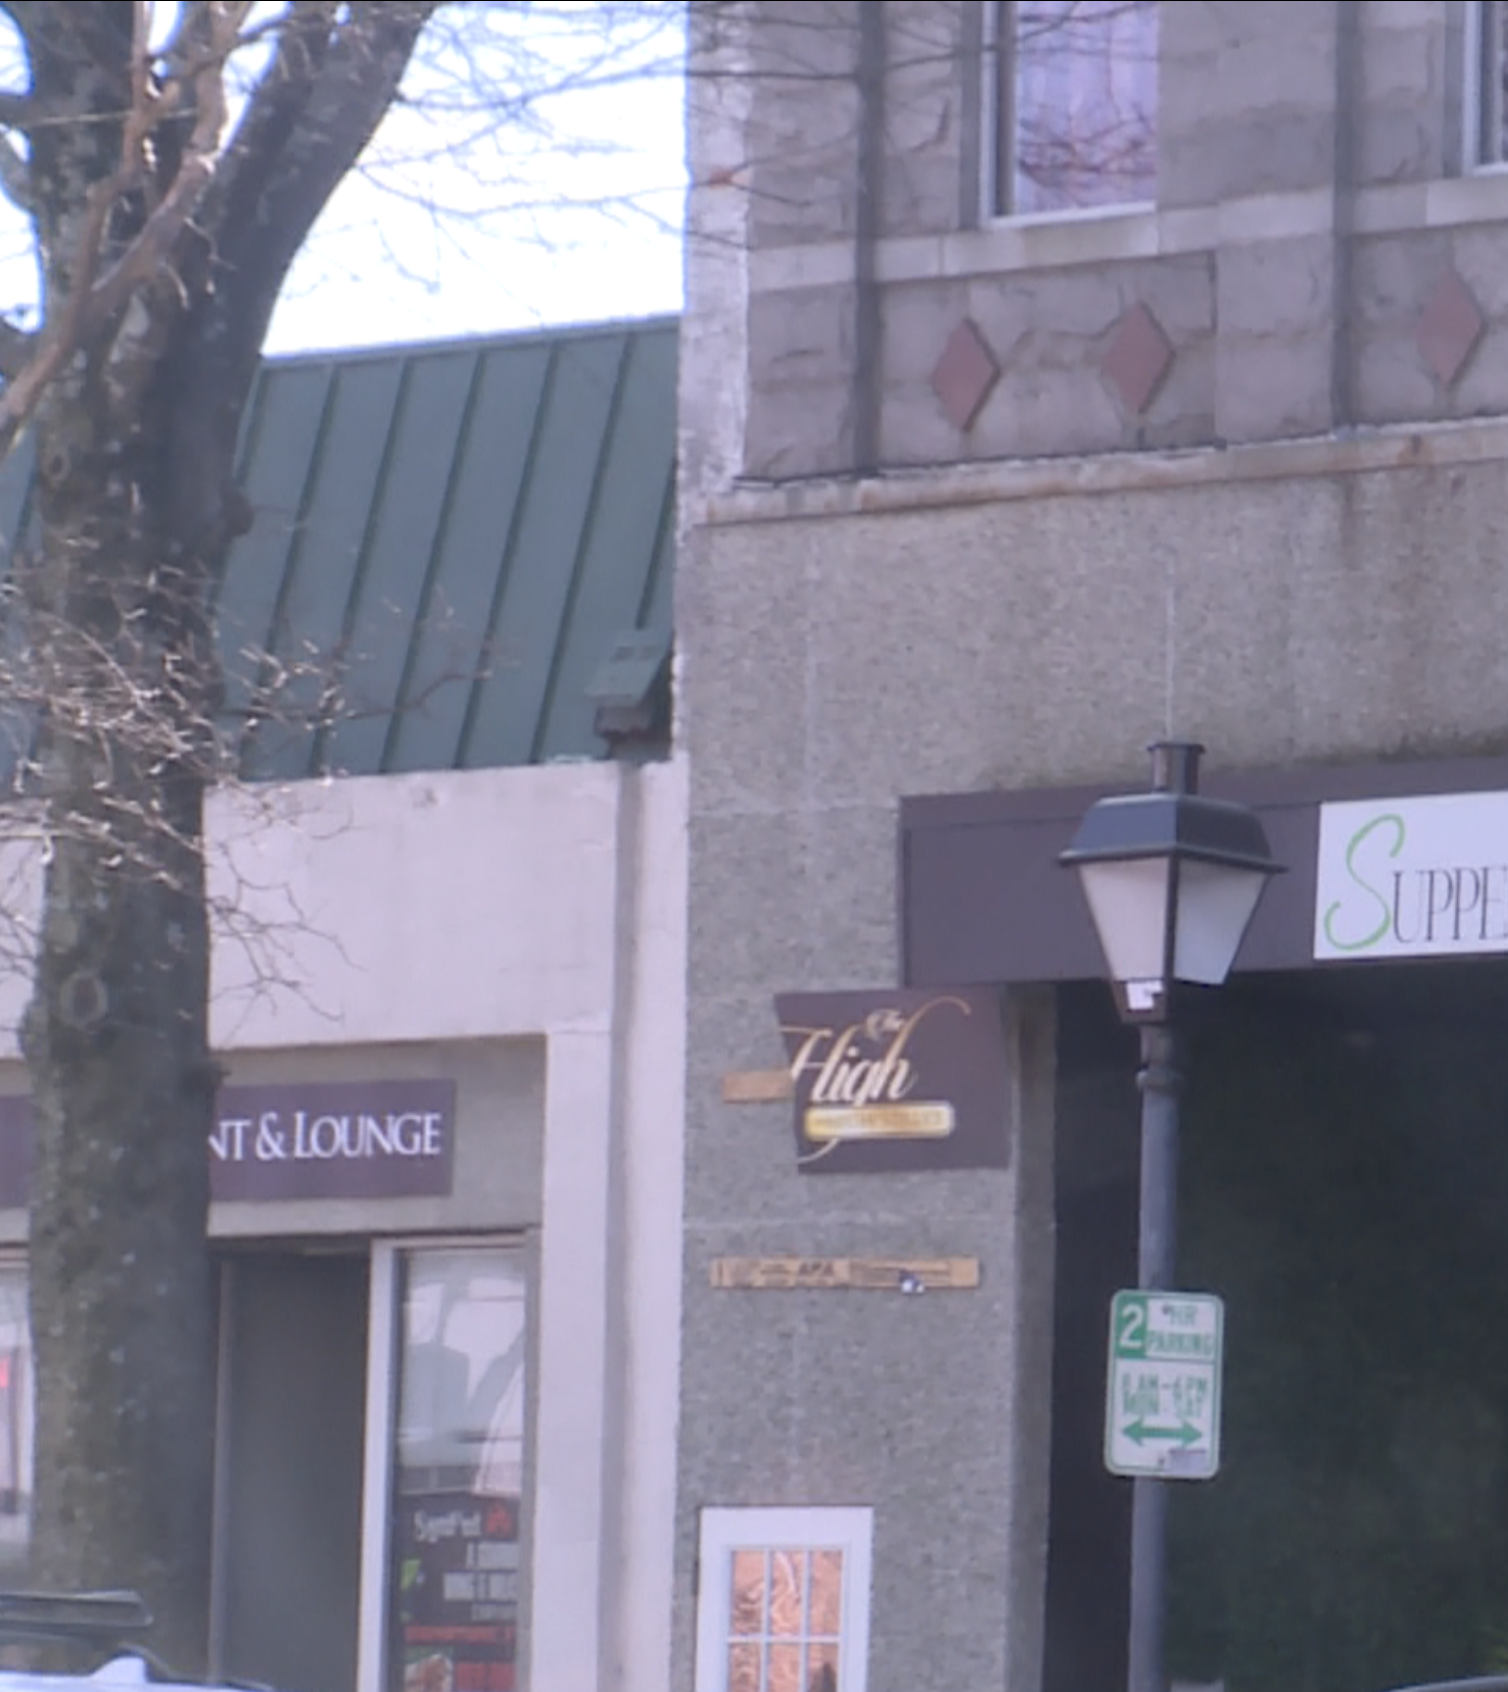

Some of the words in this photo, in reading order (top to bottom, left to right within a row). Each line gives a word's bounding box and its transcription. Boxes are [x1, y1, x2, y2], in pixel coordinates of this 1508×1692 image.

[256, 1111, 287, 1161] &
[294, 1110, 442, 1158] LOUNGE
[1119, 1303, 1144, 1350] 2
[1149, 1332, 1213, 1356] PARKING
